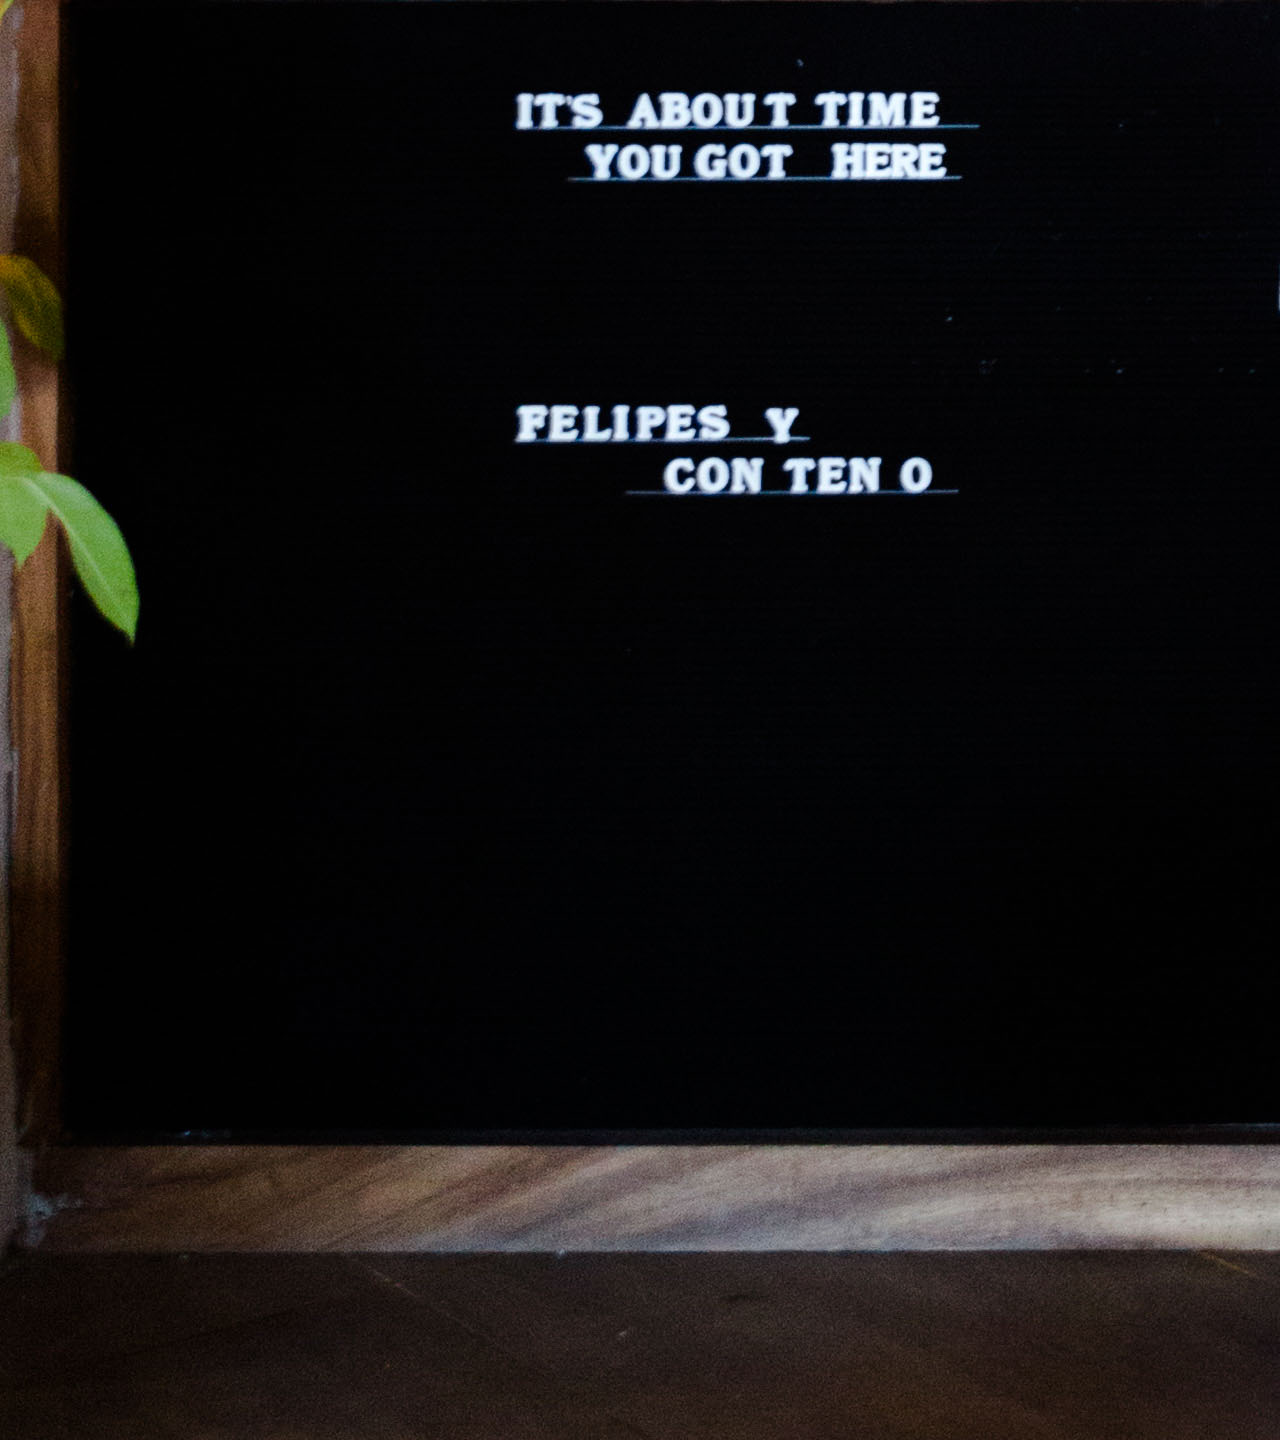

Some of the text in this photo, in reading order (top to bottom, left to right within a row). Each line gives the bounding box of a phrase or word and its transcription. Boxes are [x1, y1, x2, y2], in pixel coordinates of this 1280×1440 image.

[515, 92, 940, 128] IT'S ABOUT TIME
[584, 142, 947, 180] YOU GOT HERE
[515, 404, 800, 443] FELIPES Y
[663, 457, 764, 494] CON
